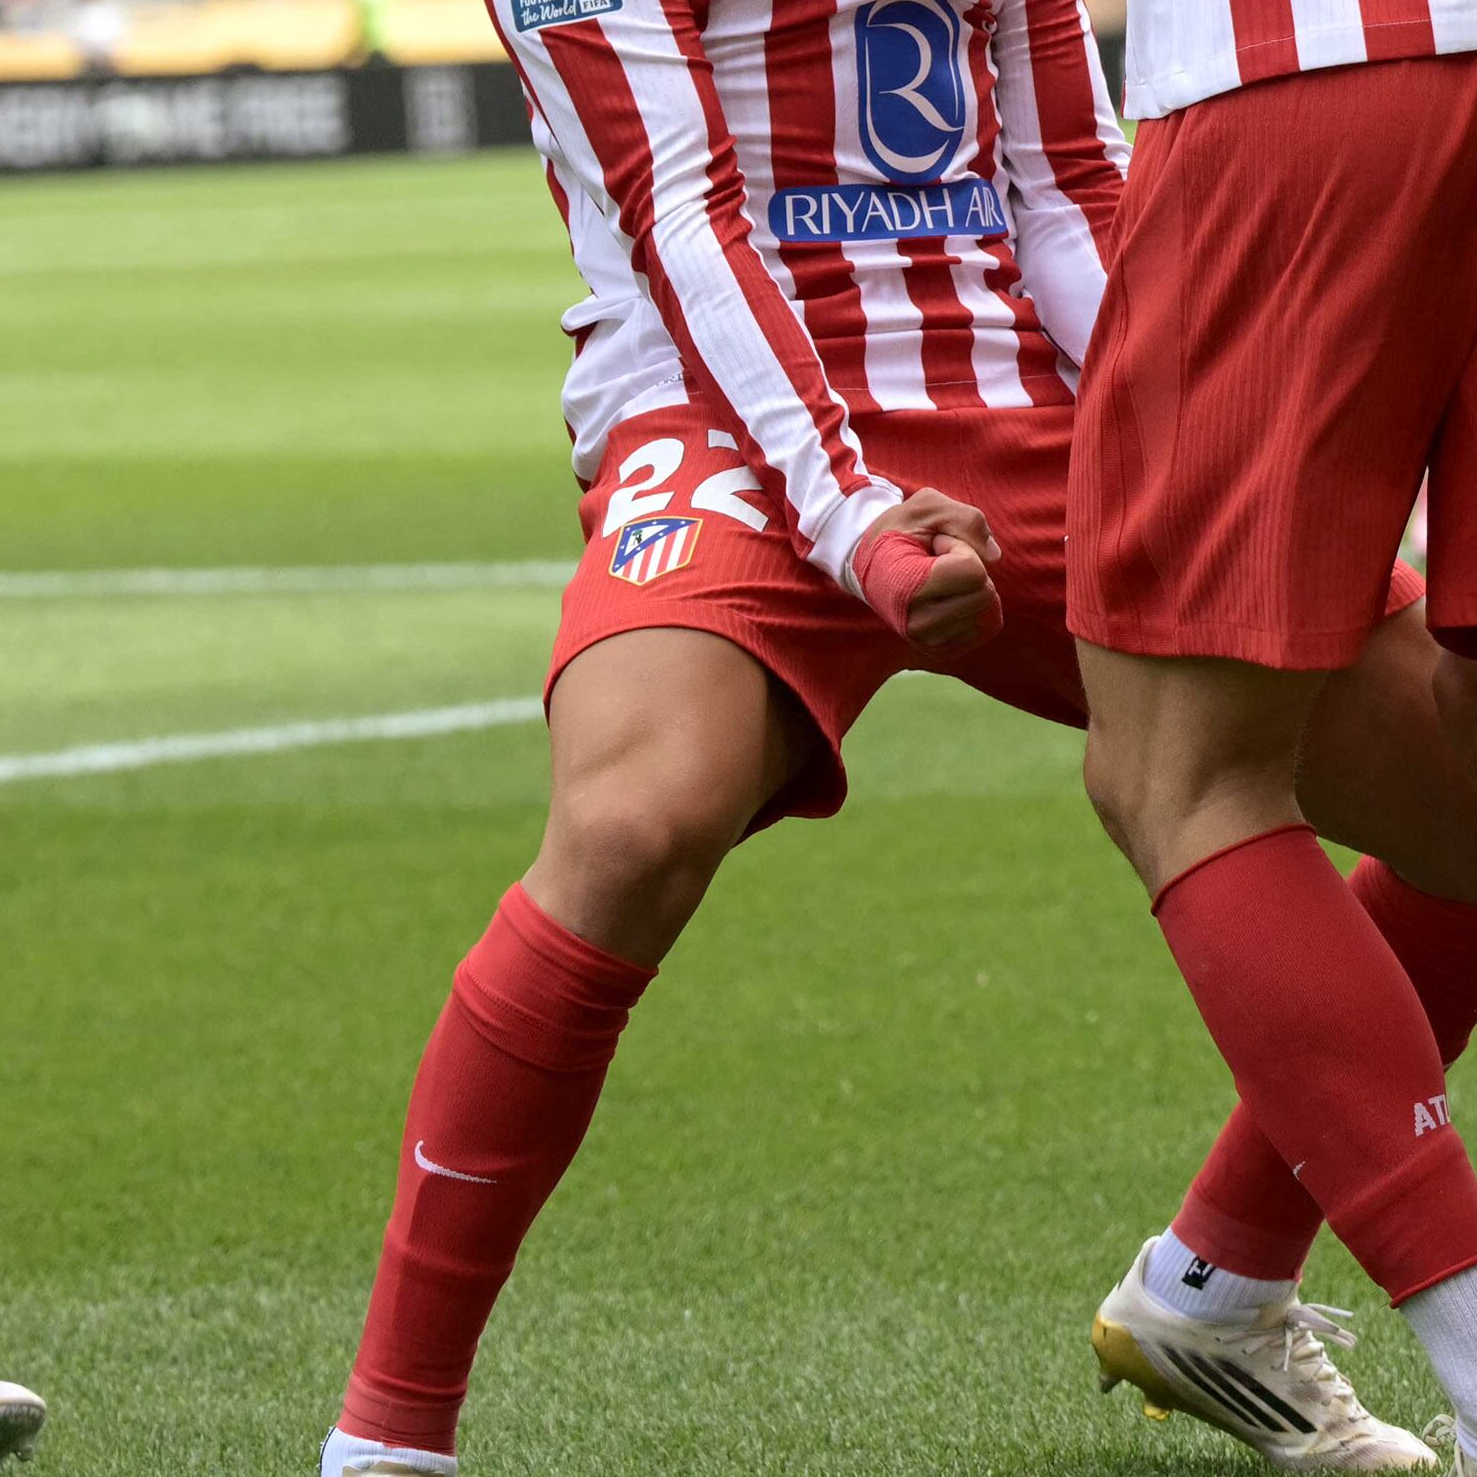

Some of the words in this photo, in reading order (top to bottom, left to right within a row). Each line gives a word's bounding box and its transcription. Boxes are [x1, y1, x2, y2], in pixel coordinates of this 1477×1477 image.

[521, 7, 540, 27] the
[784, 188, 955, 236] RIYADH
[965, 185, 1004, 229] AIR
[601, 428, 770, 539] 22
